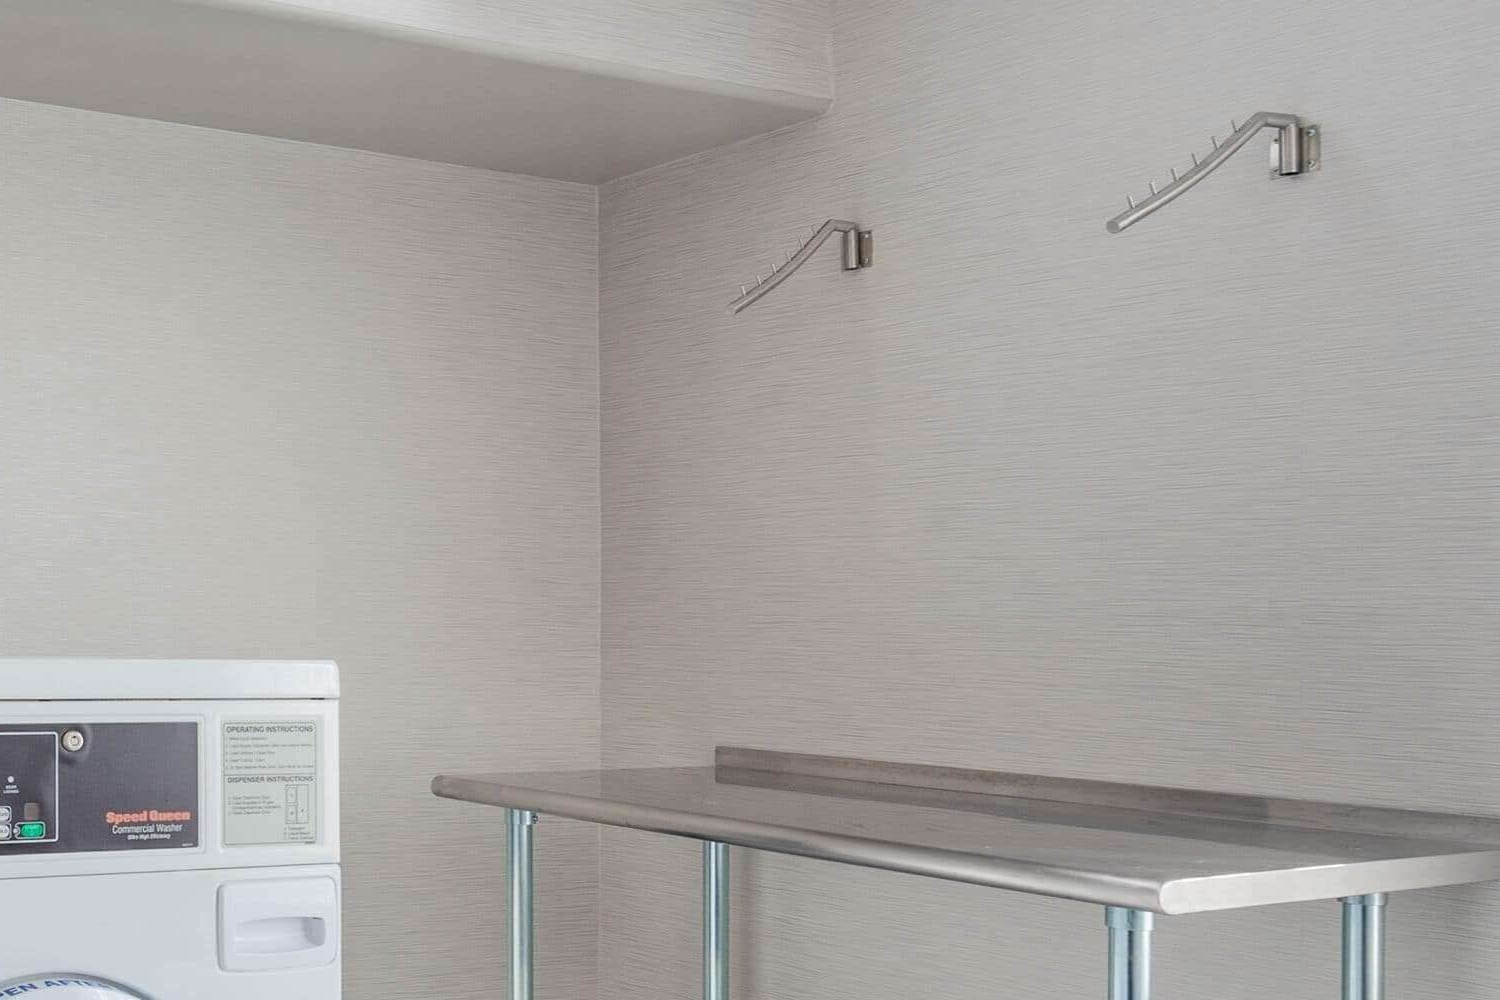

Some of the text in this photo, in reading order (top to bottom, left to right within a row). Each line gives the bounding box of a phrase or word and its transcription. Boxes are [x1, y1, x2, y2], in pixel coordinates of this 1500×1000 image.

[226, 725, 314, 733] OPERATING INSTRUCTIONS
[106, 810, 190, 825] Speed Queen
[112, 823, 183, 834] Commercial Washer
